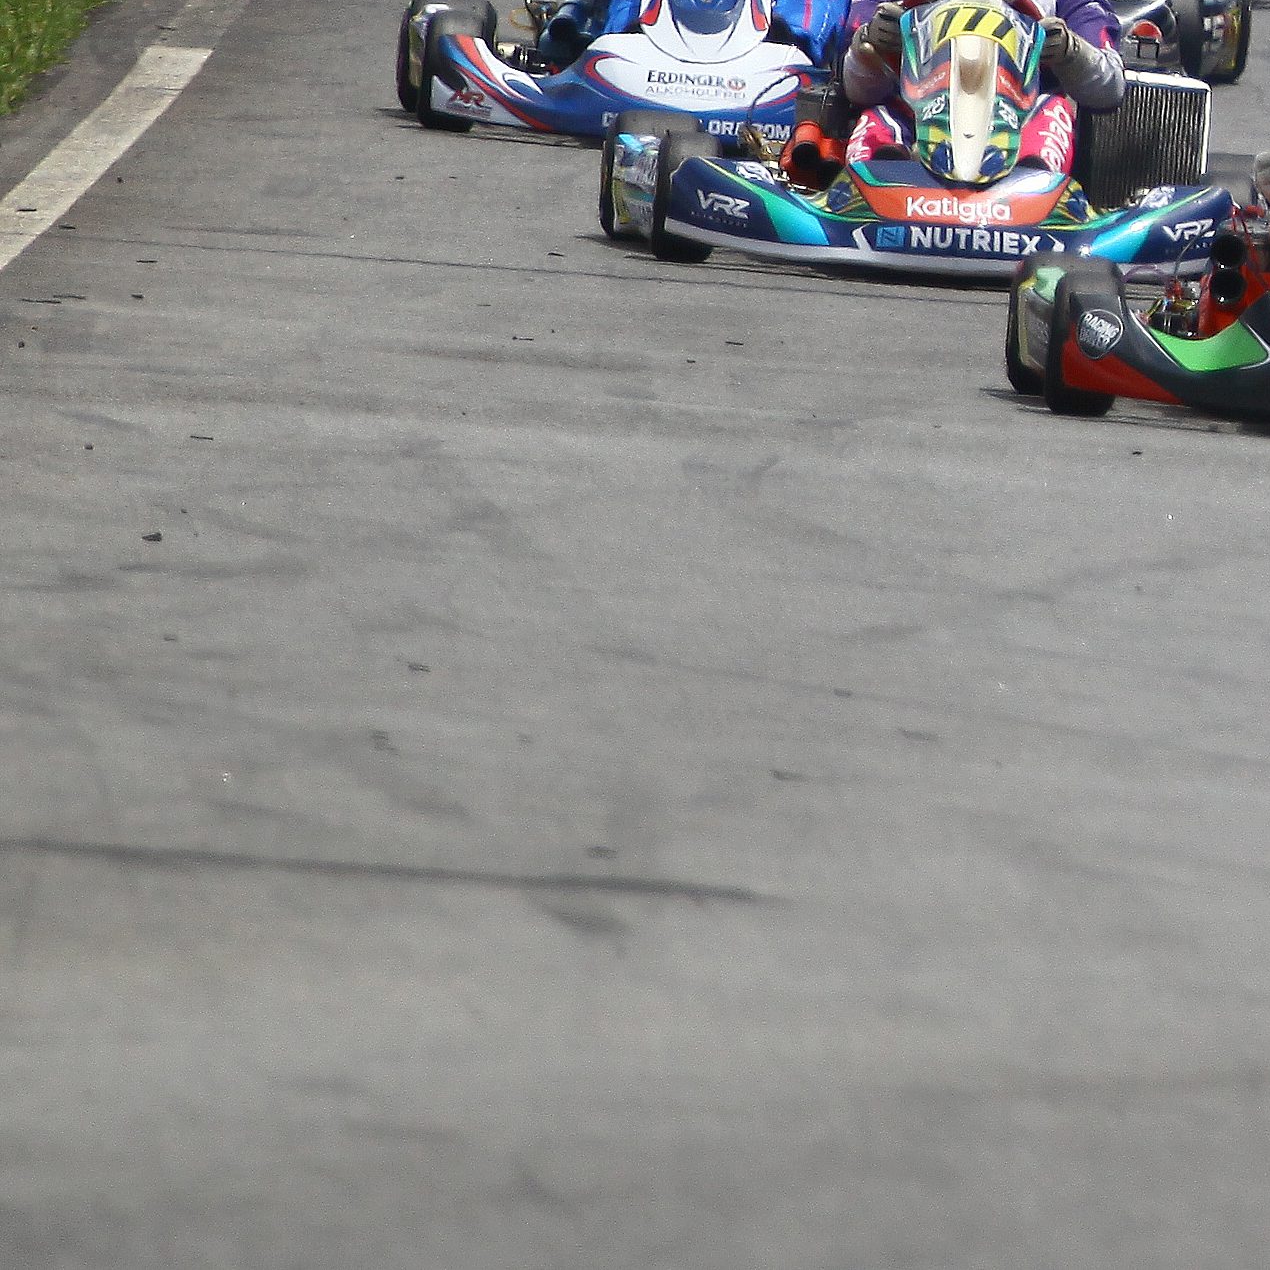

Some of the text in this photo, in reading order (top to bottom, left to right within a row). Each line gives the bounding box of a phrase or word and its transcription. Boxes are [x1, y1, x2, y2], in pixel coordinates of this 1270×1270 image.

[935, 6, 1017, 46] 777
[646, 69, 725, 88] ERDINGER
[697, 188, 751, 221] VRZ
[905, 196, 1012, 225] Katigua
[910, 225, 1041, 257] NUTRIEX
